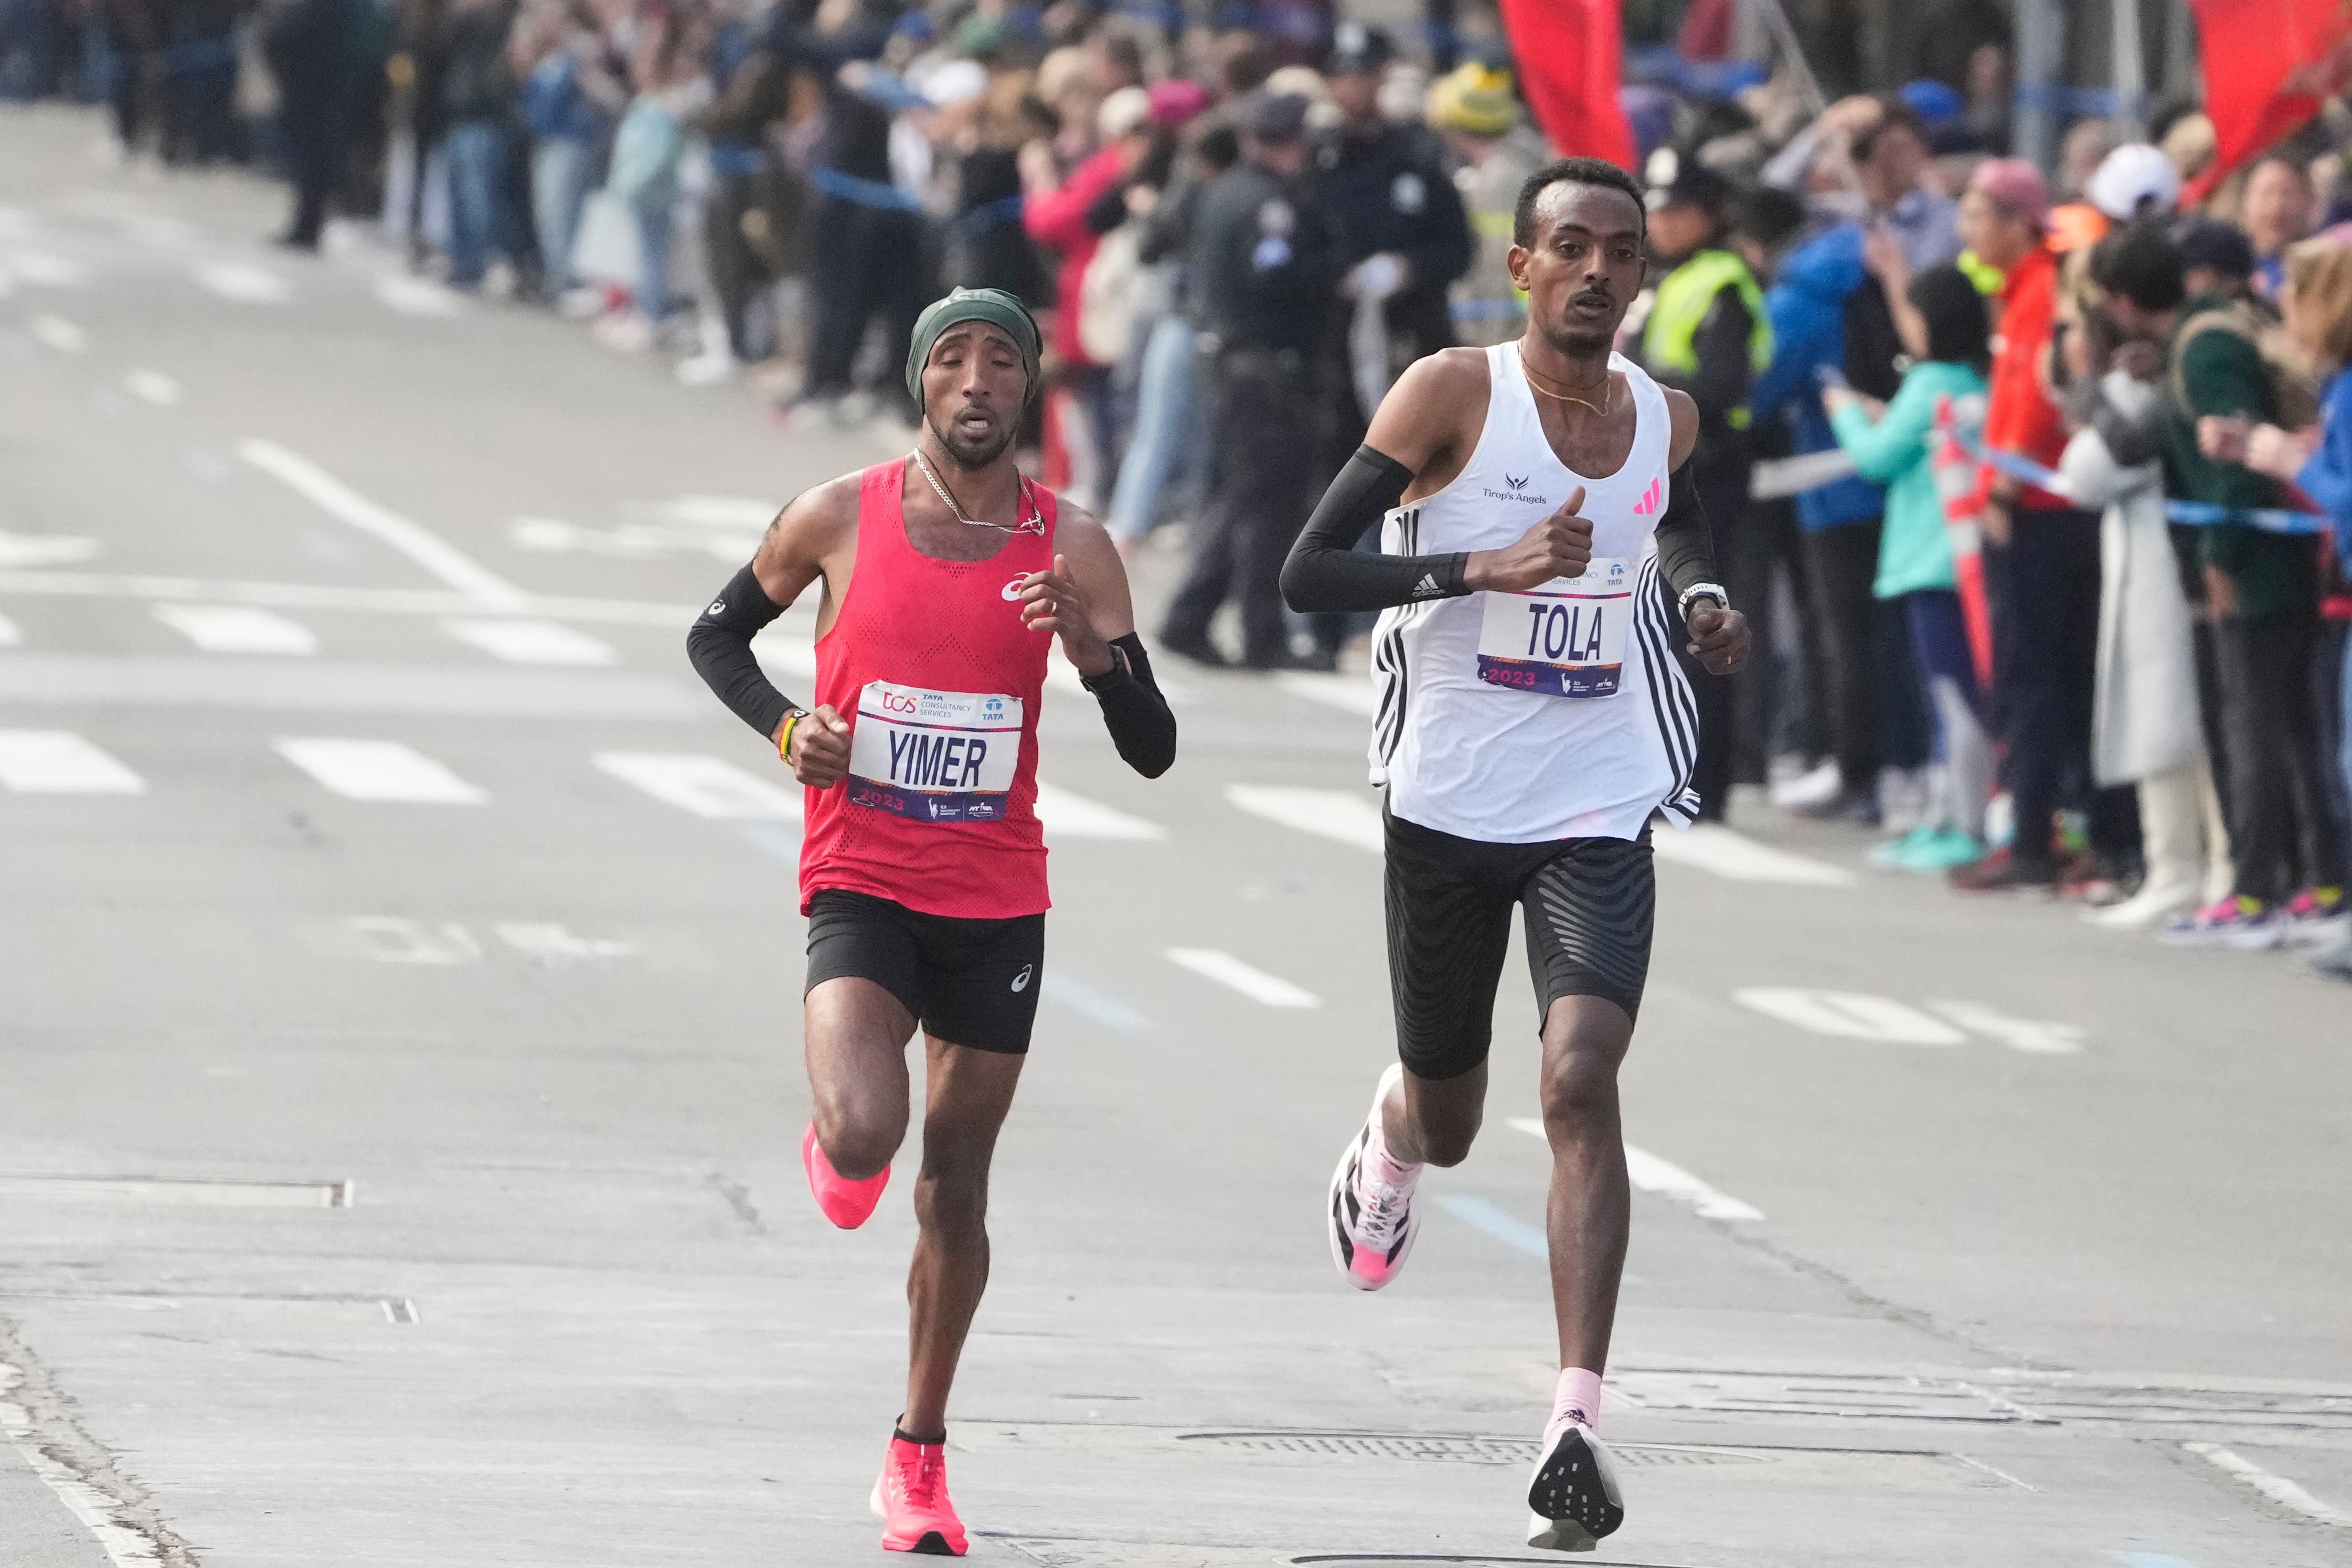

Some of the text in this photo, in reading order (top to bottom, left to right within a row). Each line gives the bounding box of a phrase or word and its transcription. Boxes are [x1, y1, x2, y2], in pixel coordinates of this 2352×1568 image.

[1483, 488, 1546, 504] Tirop's Angels
[1528, 604, 1602, 661] TOLA
[1488, 668, 1535, 686] 2023
[921, 701, 971, 712] CONSULTANCY
[889, 730, 987, 787] YIMER
[860, 788, 903, 811] 2023
